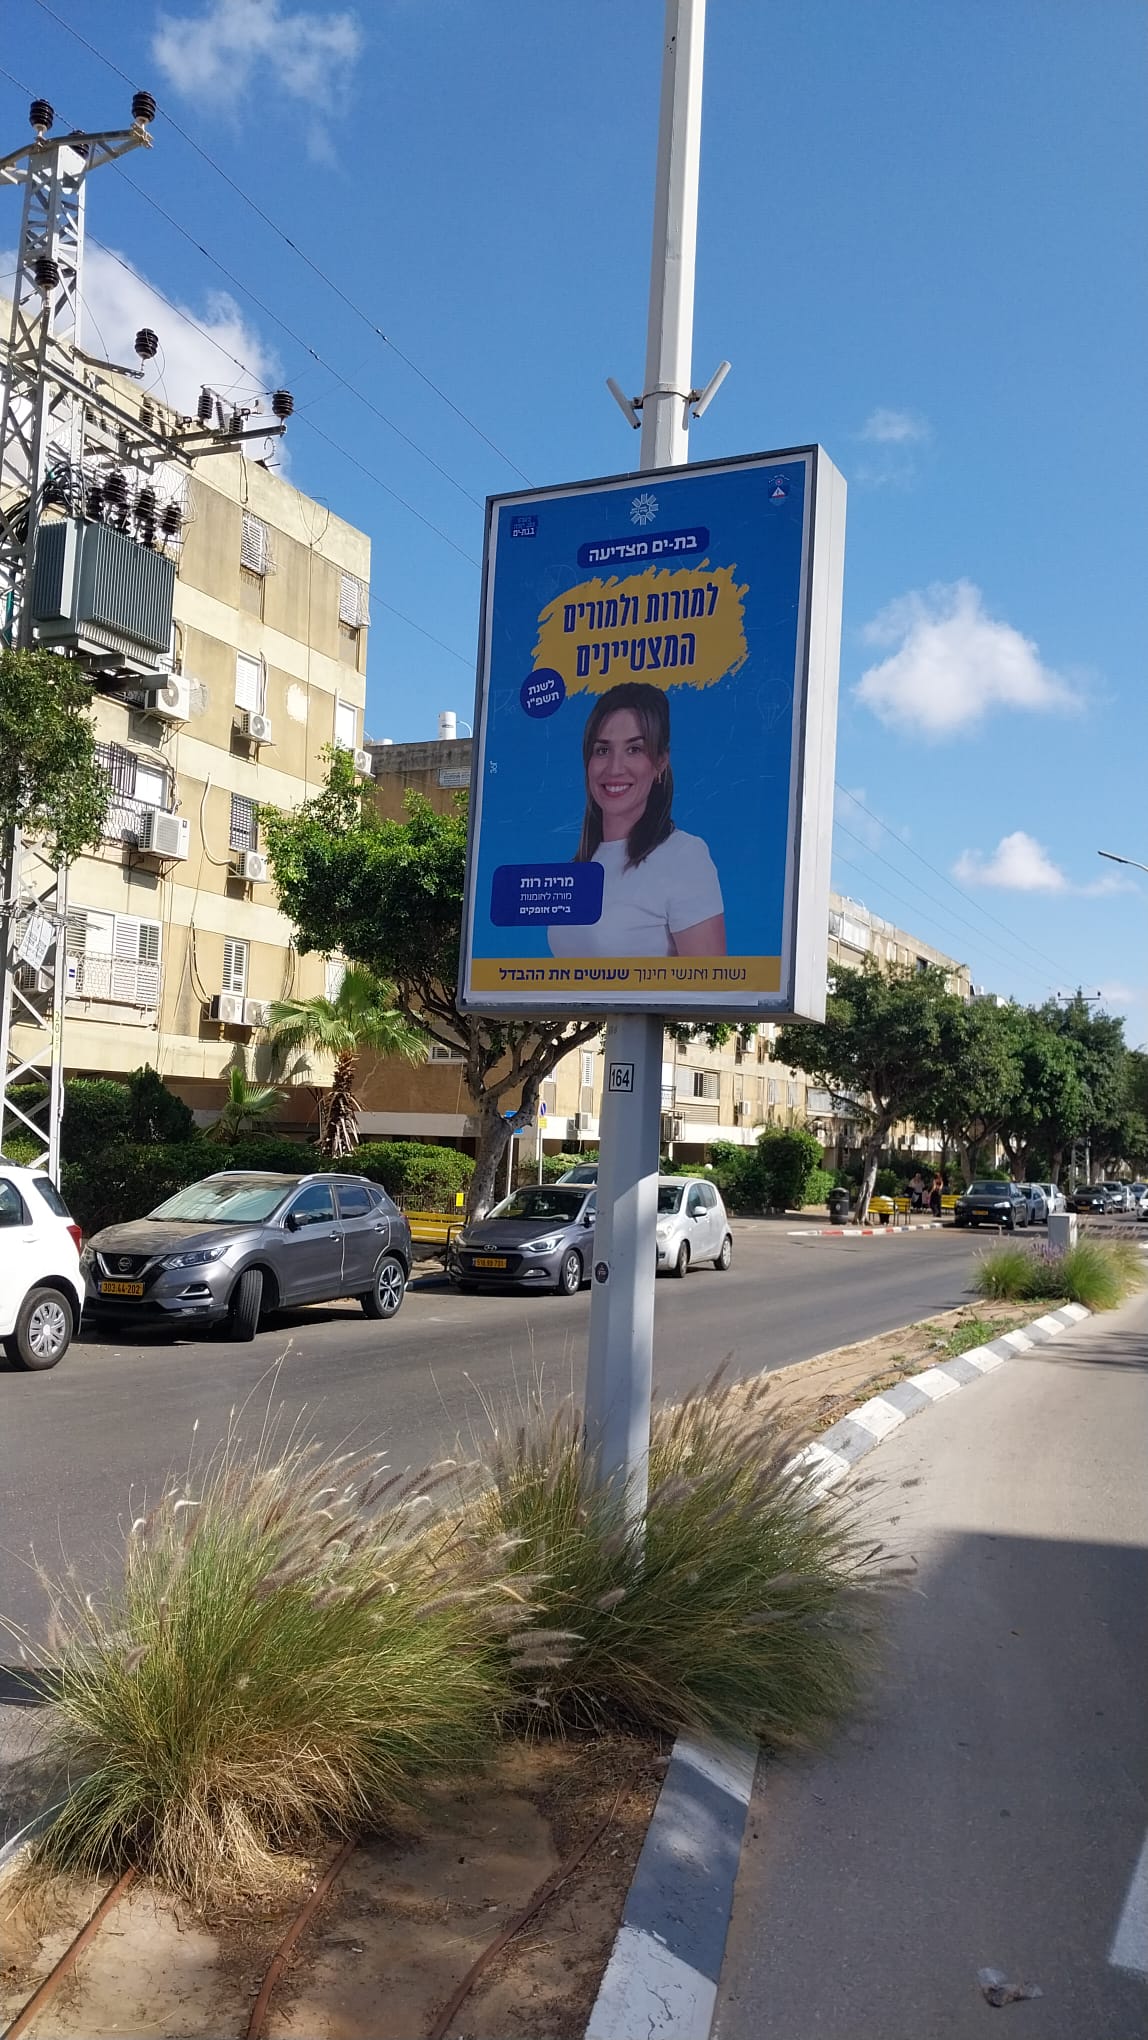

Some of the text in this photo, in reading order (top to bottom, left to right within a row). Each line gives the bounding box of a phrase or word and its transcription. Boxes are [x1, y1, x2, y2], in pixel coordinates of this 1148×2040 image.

[589, 535, 698, 562] בת-ים מצדיעה
[563, 582, 719, 633] למורות ולמורים
[576, 632, 696, 677] המצטיינים
[528, 679, 555, 695] לשנת
[520, 876, 574, 888] מריה רות
[552, 892, 572, 901] מורה
[520, 906, 550, 916] אופקים
[498, 967, 746, 984] נשות ואנשי חינוך שעושים את ההבדל
[612, 1068, 631, 1088] 164
